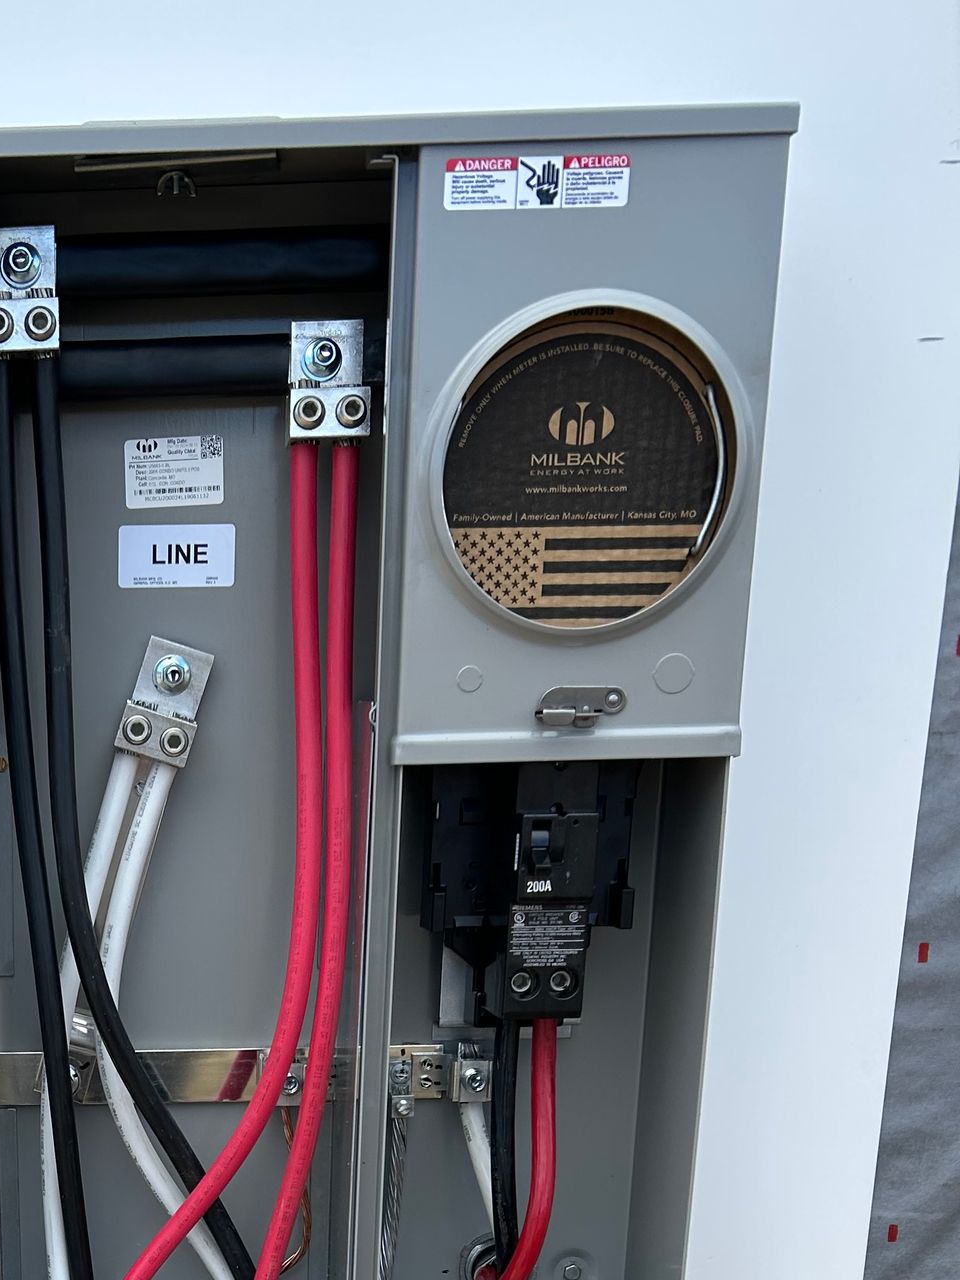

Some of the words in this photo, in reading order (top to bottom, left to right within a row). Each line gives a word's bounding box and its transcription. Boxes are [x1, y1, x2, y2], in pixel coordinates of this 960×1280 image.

[466, 160, 512, 170] DANGER
[581, 156, 628, 168] PELIGRO
[530, 452, 625, 466] MILBANK
[578, 468, 590, 476] AT
[525, 484, 628, 494] www.milbankworks.com
[561, 511, 619, 520] Manufacturer
[627, 511, 656, 519] Kansas
[659, 510, 677, 520] City,
[680, 510, 697, 518] MO
[152, 544, 209, 564] LINE
[526, 880, 552, 893] 200A
